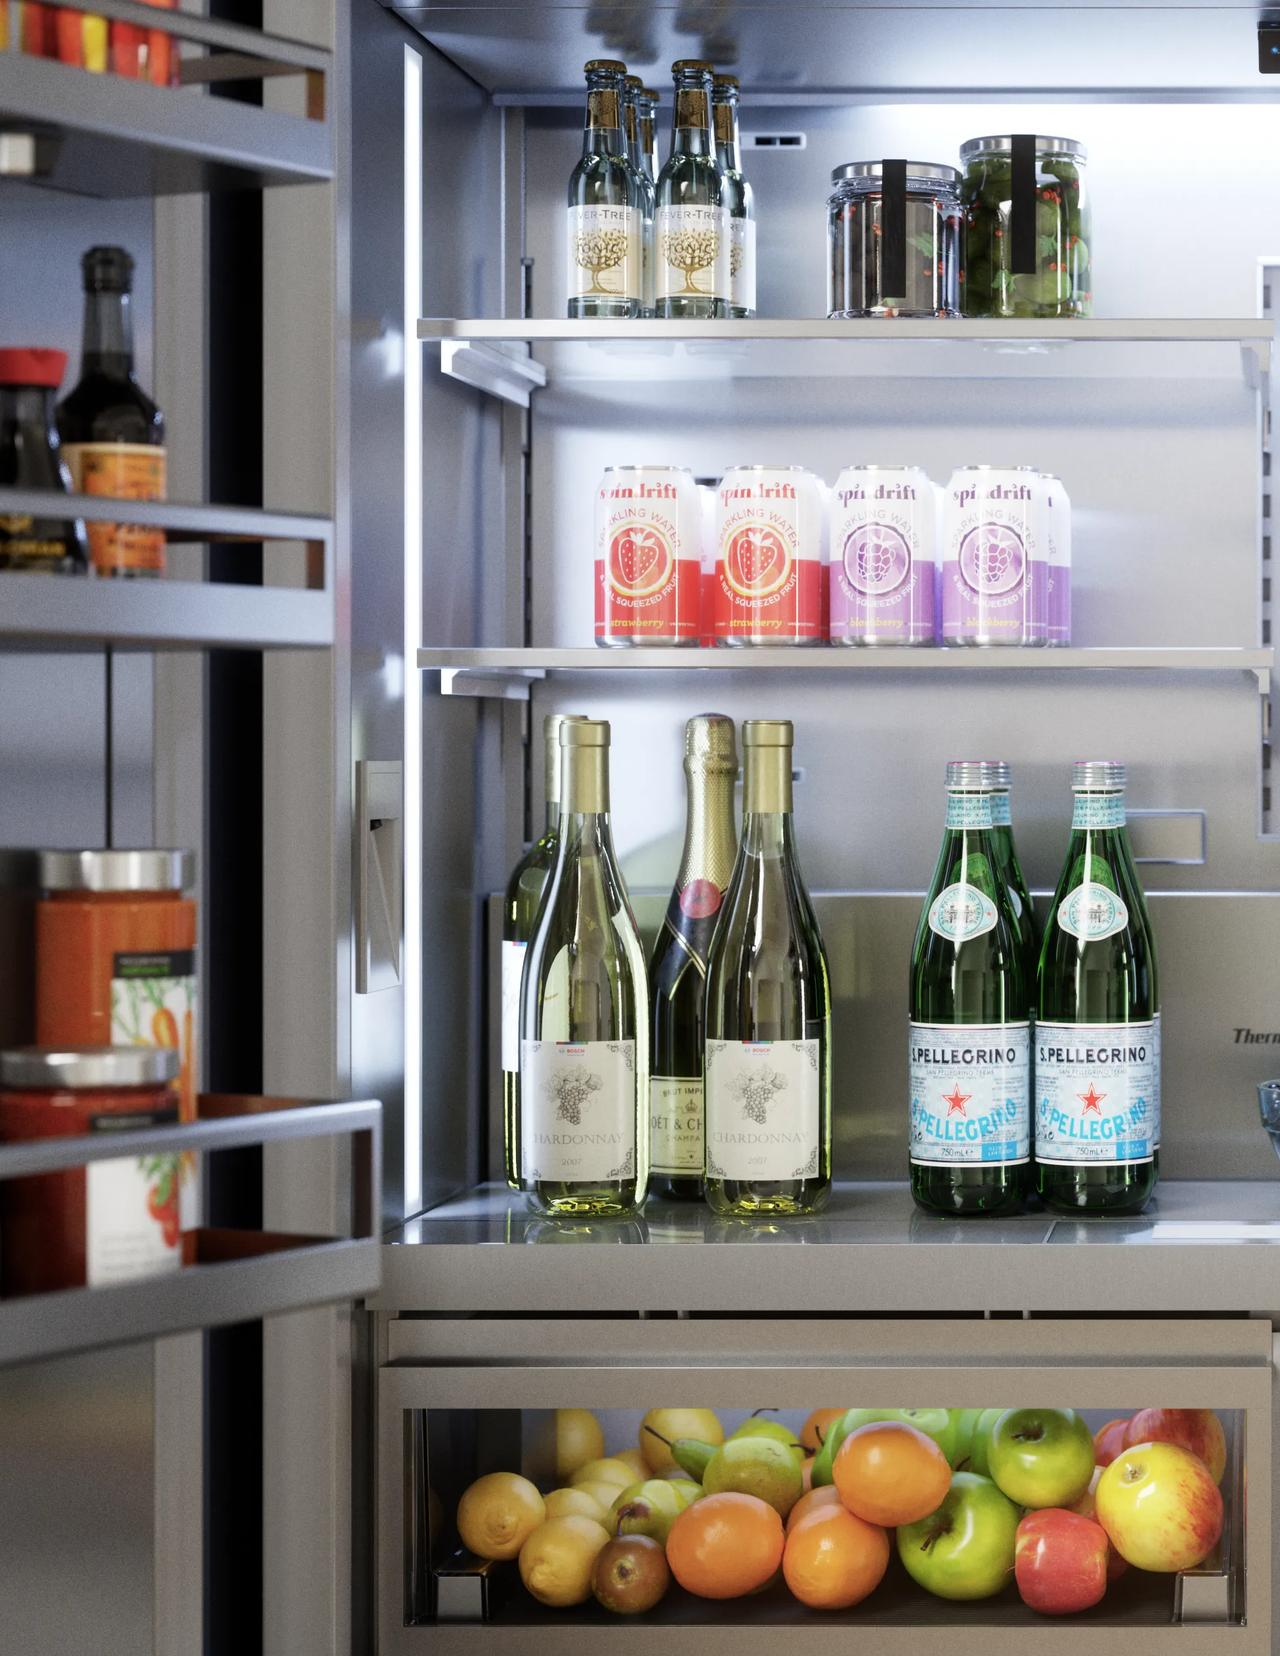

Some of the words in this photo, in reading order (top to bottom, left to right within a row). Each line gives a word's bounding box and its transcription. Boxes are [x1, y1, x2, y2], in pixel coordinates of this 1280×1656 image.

[1040, 1046, 1147, 1063] S.PELLEGRINO
[674, 1119, 683, 1130] &
[534, 1132, 625, 1146] HARDONNAY
